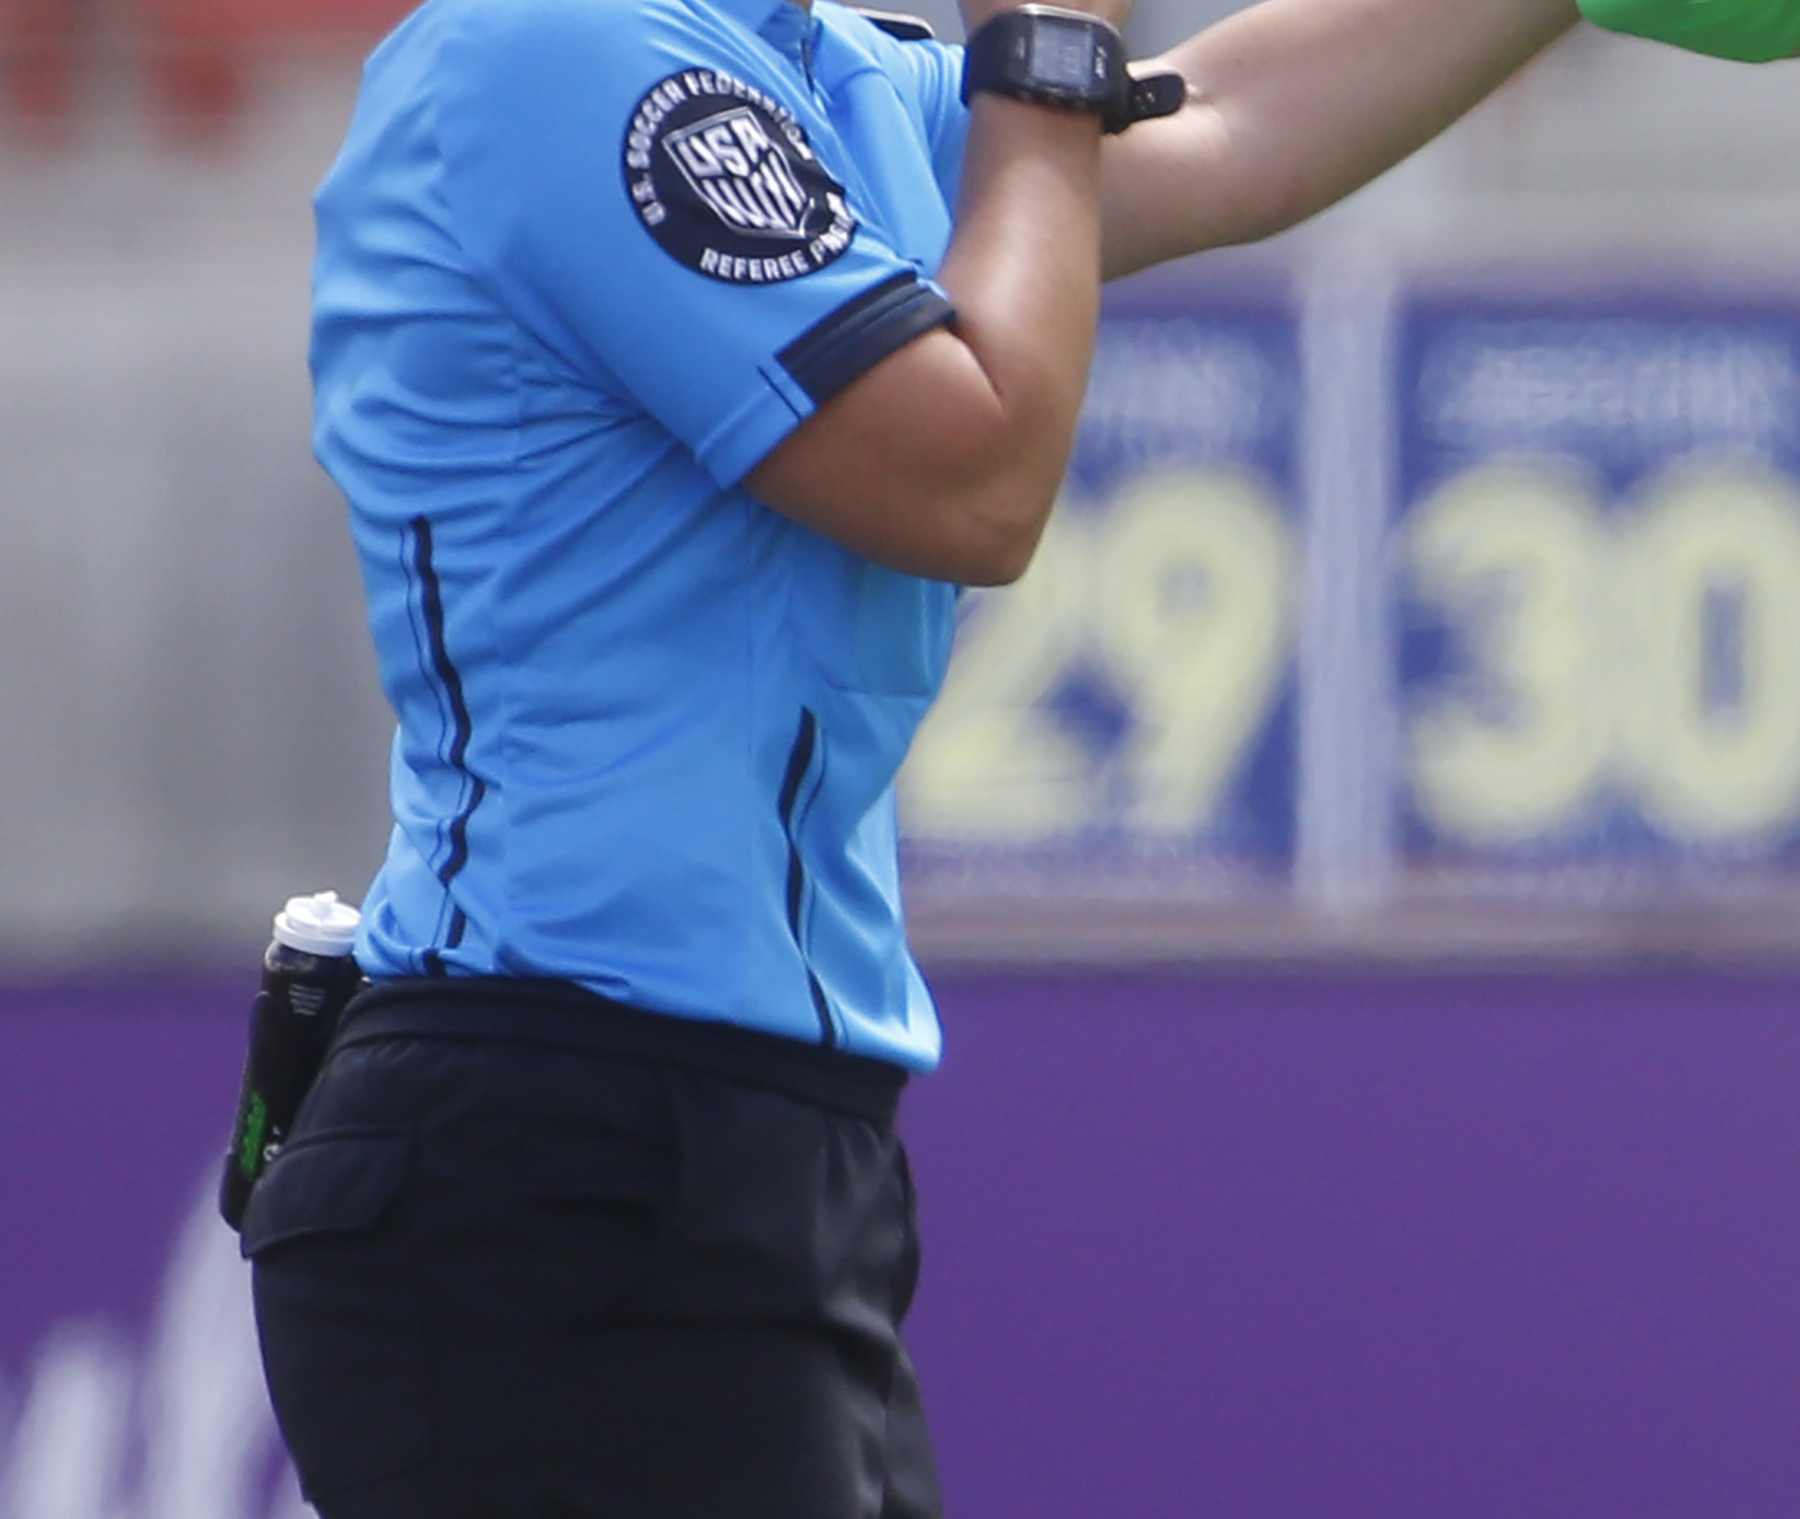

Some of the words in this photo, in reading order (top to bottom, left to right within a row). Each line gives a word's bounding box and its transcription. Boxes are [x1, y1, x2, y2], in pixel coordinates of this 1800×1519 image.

[626, 79, 687, 169] SOCCER
[676, 116, 770, 177] USA
[700, 248, 810, 282] REFEREE
